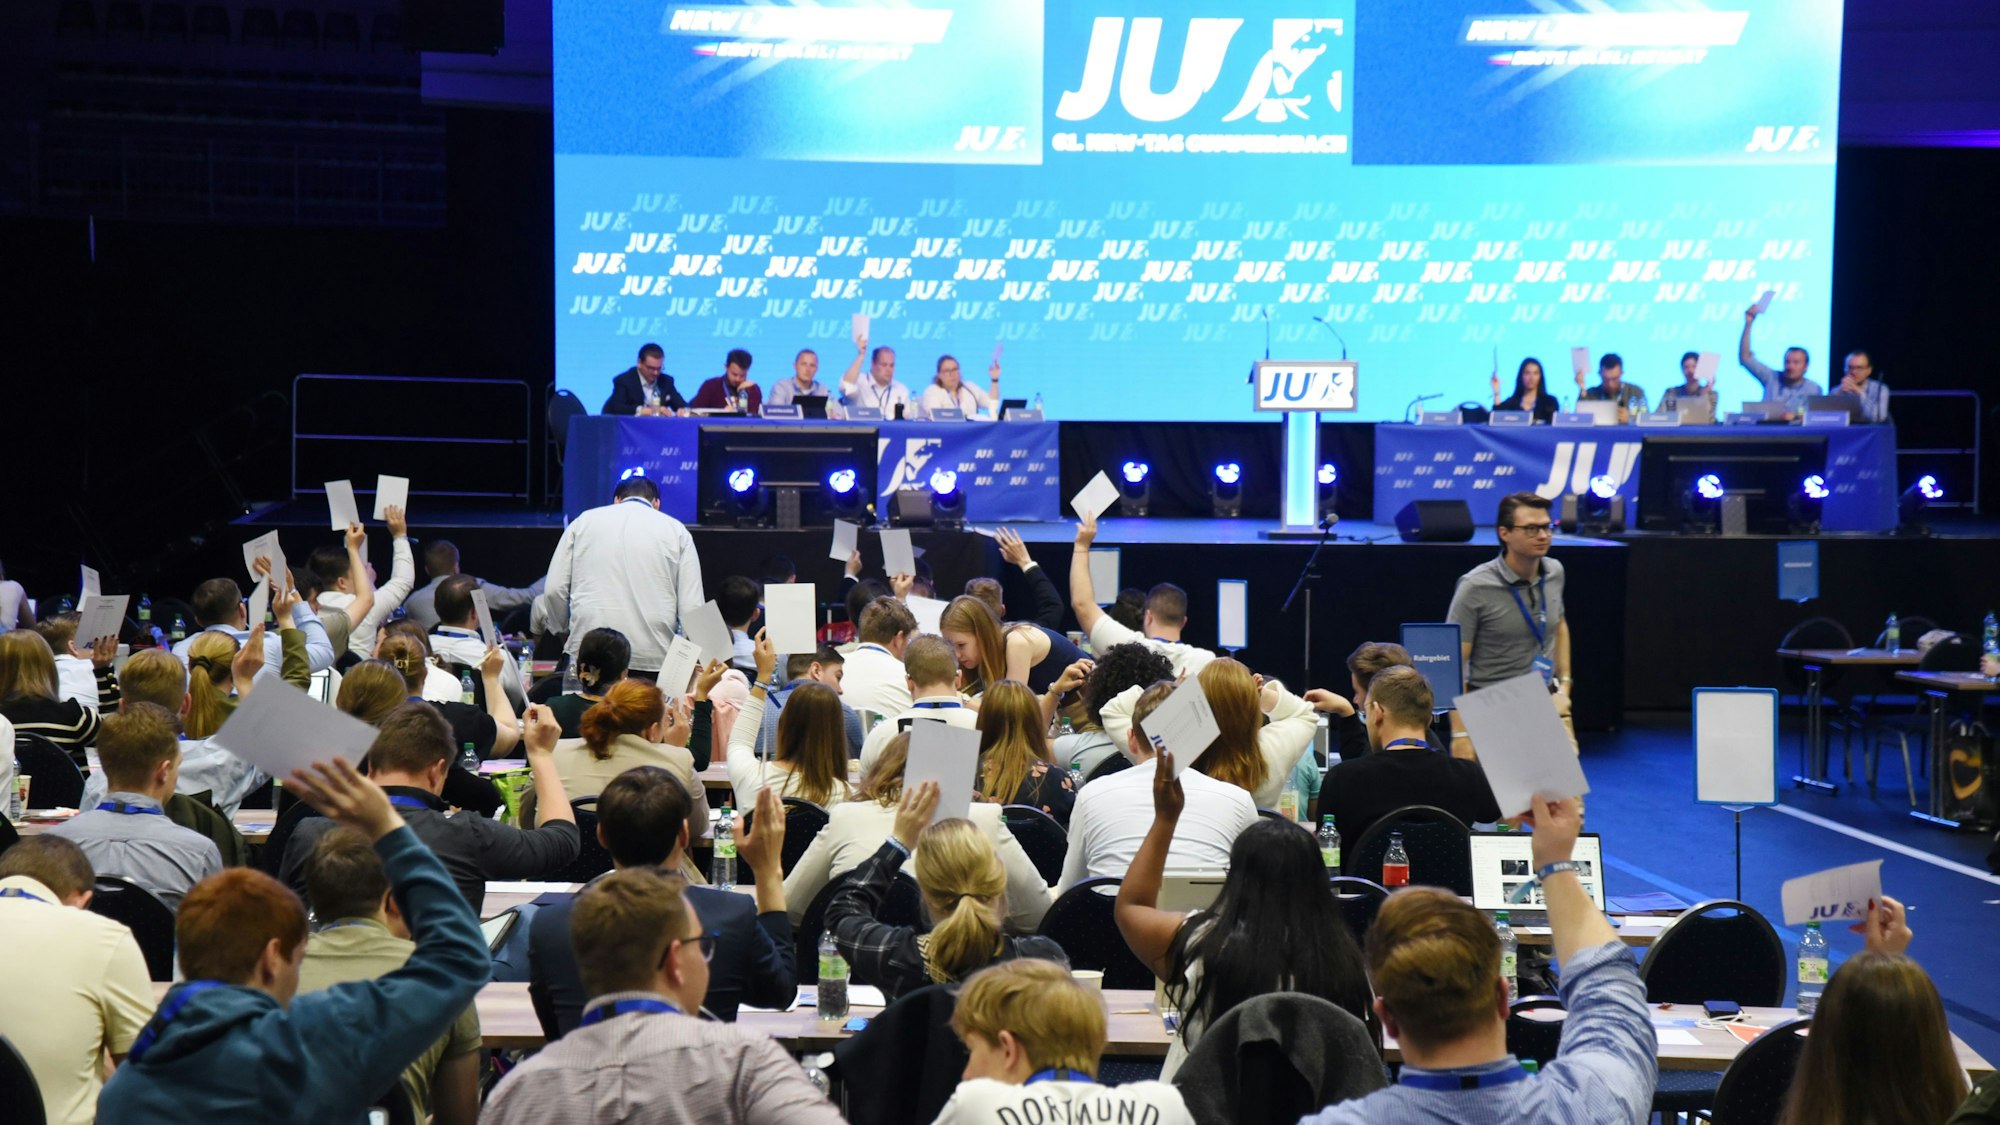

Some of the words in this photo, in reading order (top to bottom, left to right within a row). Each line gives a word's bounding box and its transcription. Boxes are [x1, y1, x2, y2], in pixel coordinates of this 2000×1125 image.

[1055, 17, 1244, 122] JU
[1264, 372, 1316, 401] JU
[1413, 653, 1450, 664] Ruhrgebiet
[1809, 903, 1840, 920] JU
[997, 1095, 1159, 1125] DORTMUND
